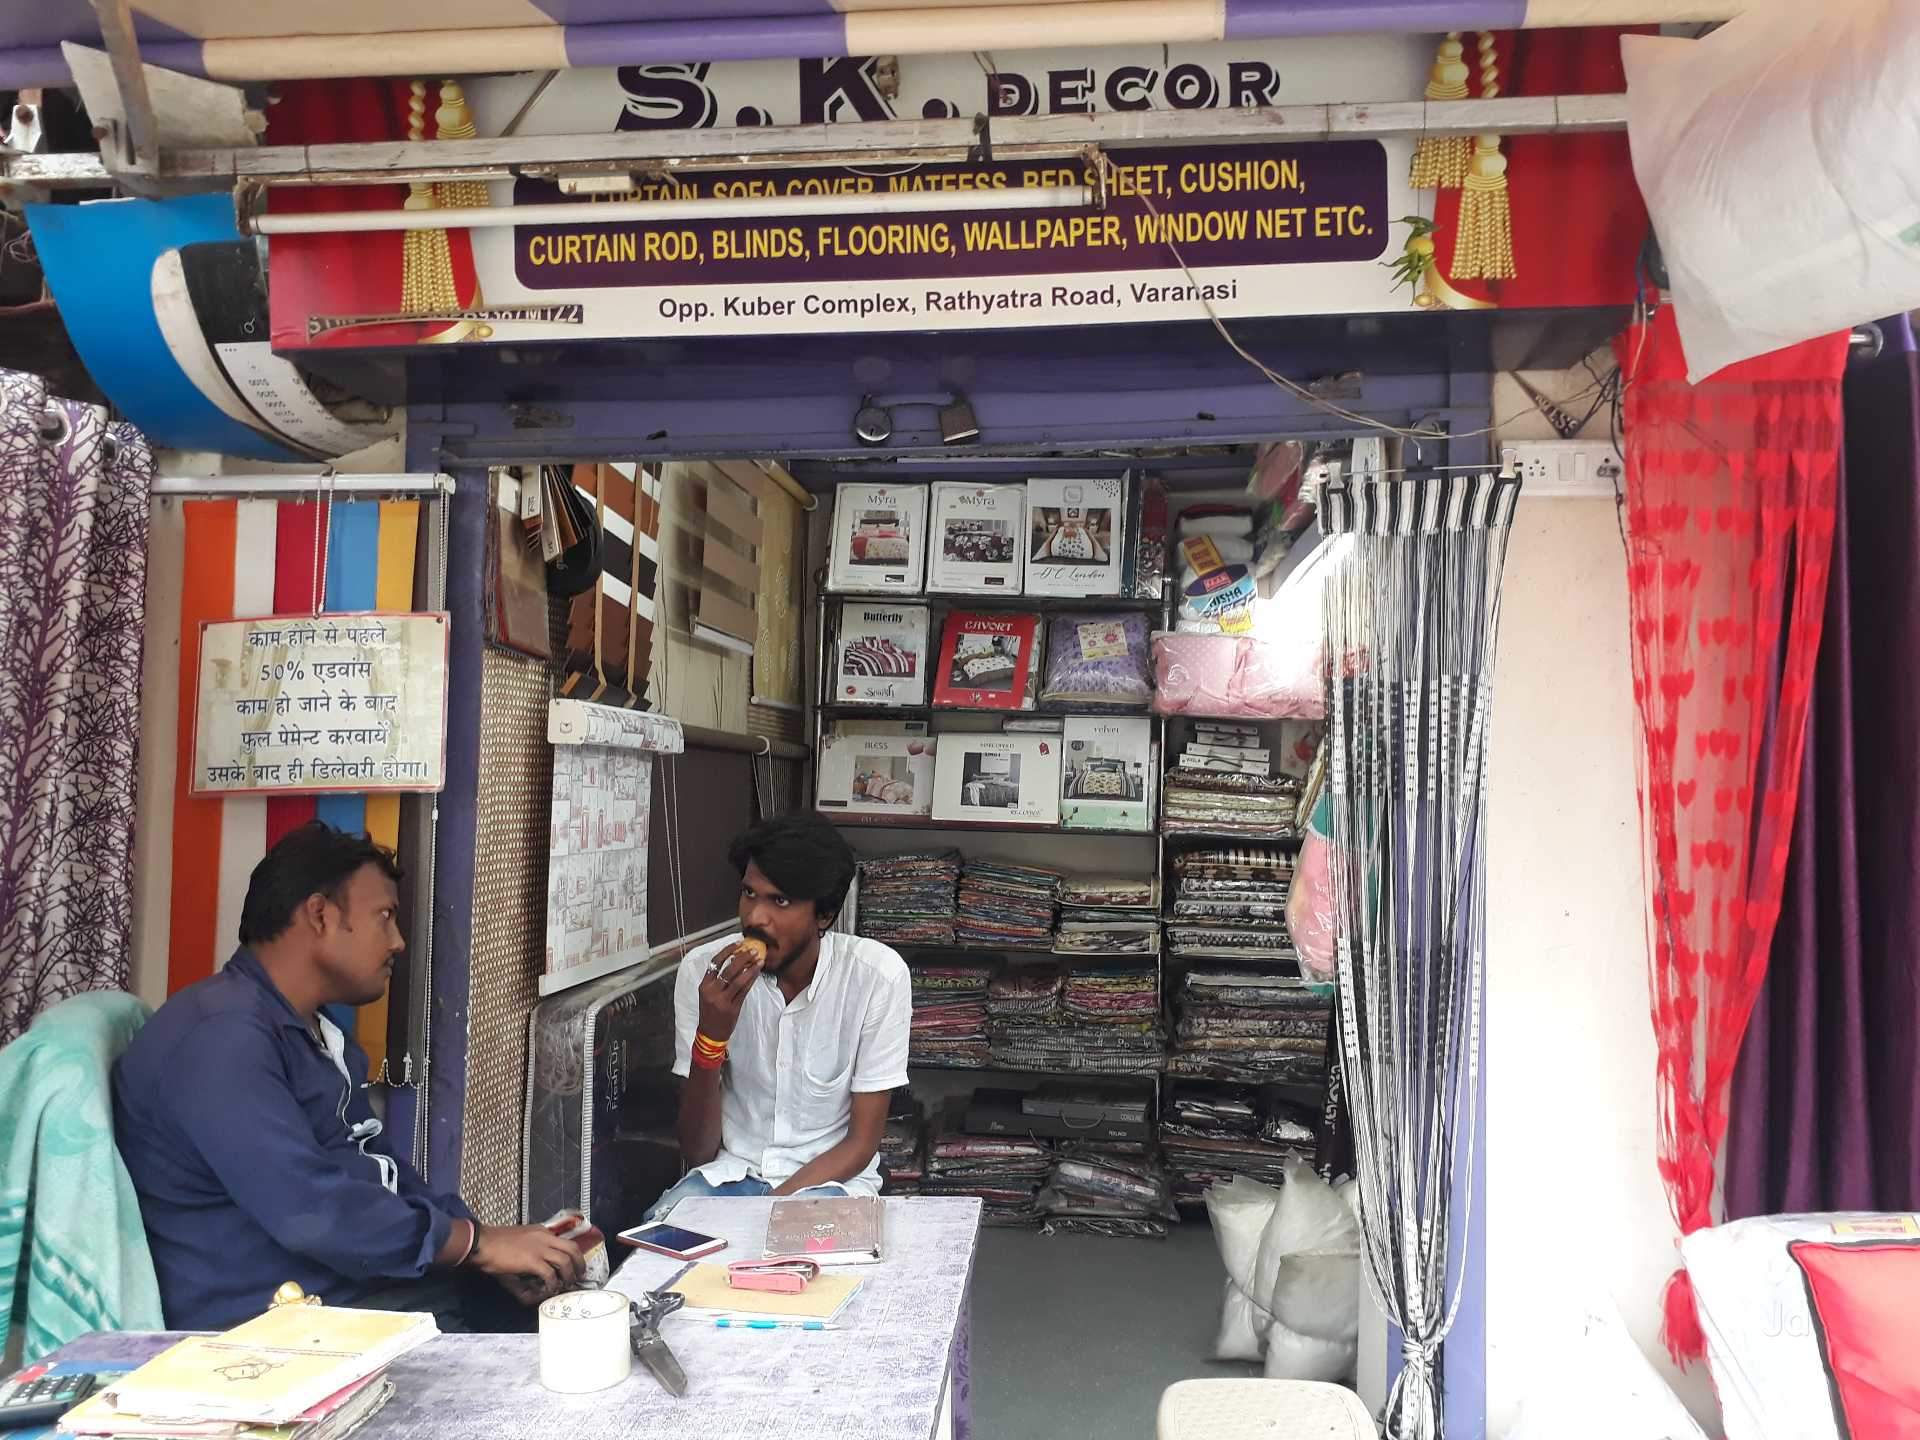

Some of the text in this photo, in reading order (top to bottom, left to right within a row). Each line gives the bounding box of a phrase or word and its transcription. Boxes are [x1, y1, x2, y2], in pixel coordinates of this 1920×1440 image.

[986, 62, 1281, 116] DECOR
[1179, 159, 1305, 195] CUSHION,
[529, 204, 1374, 266] CURTAIN ROD, BLINDS, FLOORING, WALLPAPER, WINDOW NET ETC.
[658, 279, 1238, 322] Opp. Kuber Complex, Rathyatra Road, Varanasi
[249, 620, 388, 648] काम होने से पहले
[260, 657, 373, 685] 50% एडवांस
[236, 688, 399, 716] काम हो जाने के बाद
[278, 724, 321, 747] पेमेन्ट
[328, 721, 393, 747] करवायें
[207, 759, 247, 783] उसके
[253, 766, 281, 784] बाद
[287, 758, 305, 783] ही
[311, 755, 376, 779] डिलेवरी
